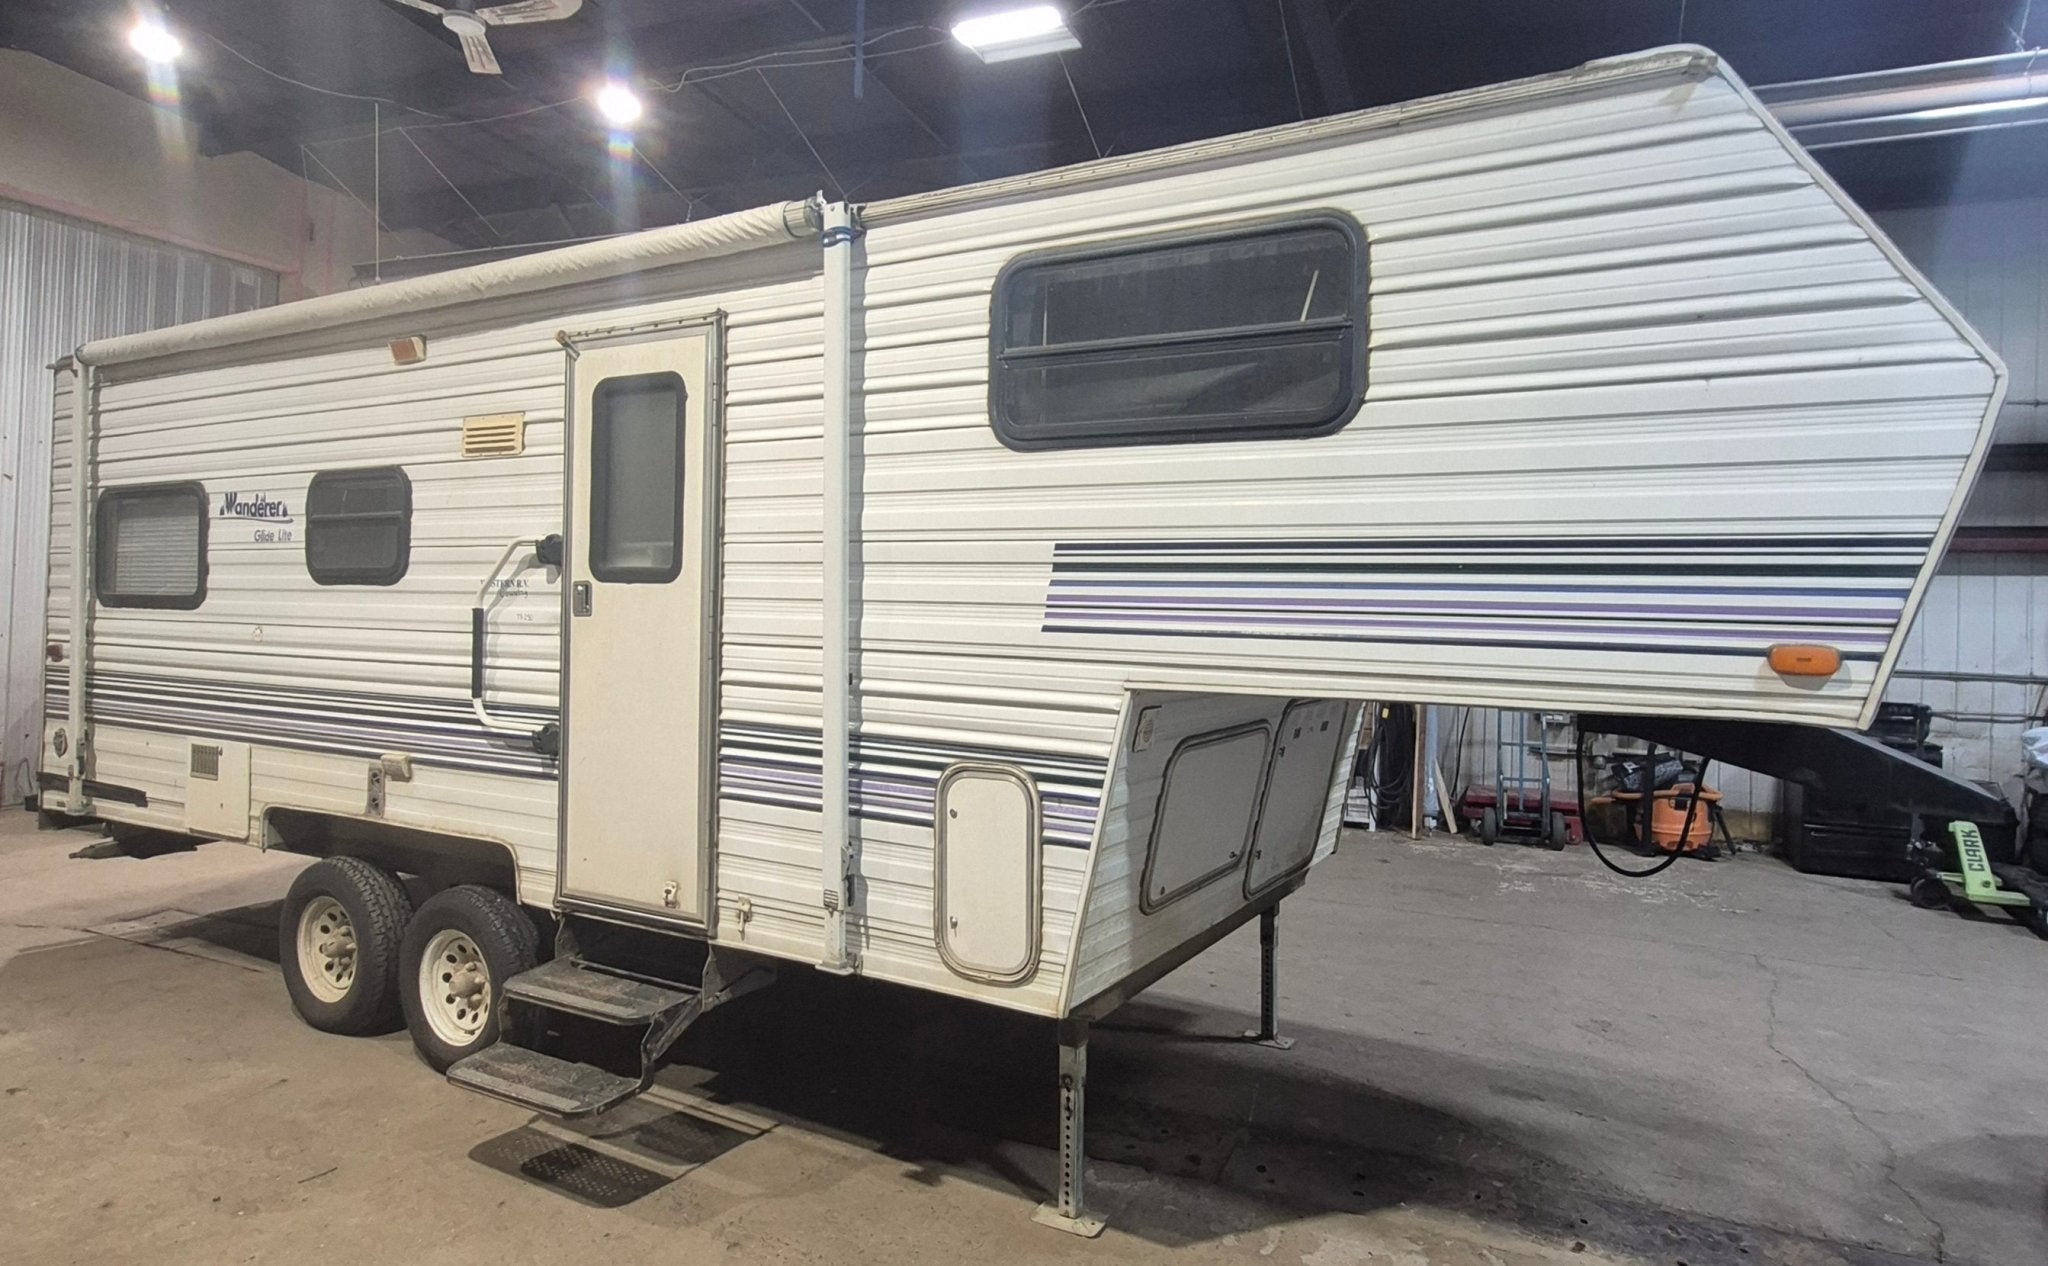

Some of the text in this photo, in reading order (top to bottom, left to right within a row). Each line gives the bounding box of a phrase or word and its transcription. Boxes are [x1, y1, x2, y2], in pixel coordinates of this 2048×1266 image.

[224, 491, 282, 517] Wanderer
[254, 528, 292, 542] Glide Lite
[1961, 830, 1985, 871] CLARK
